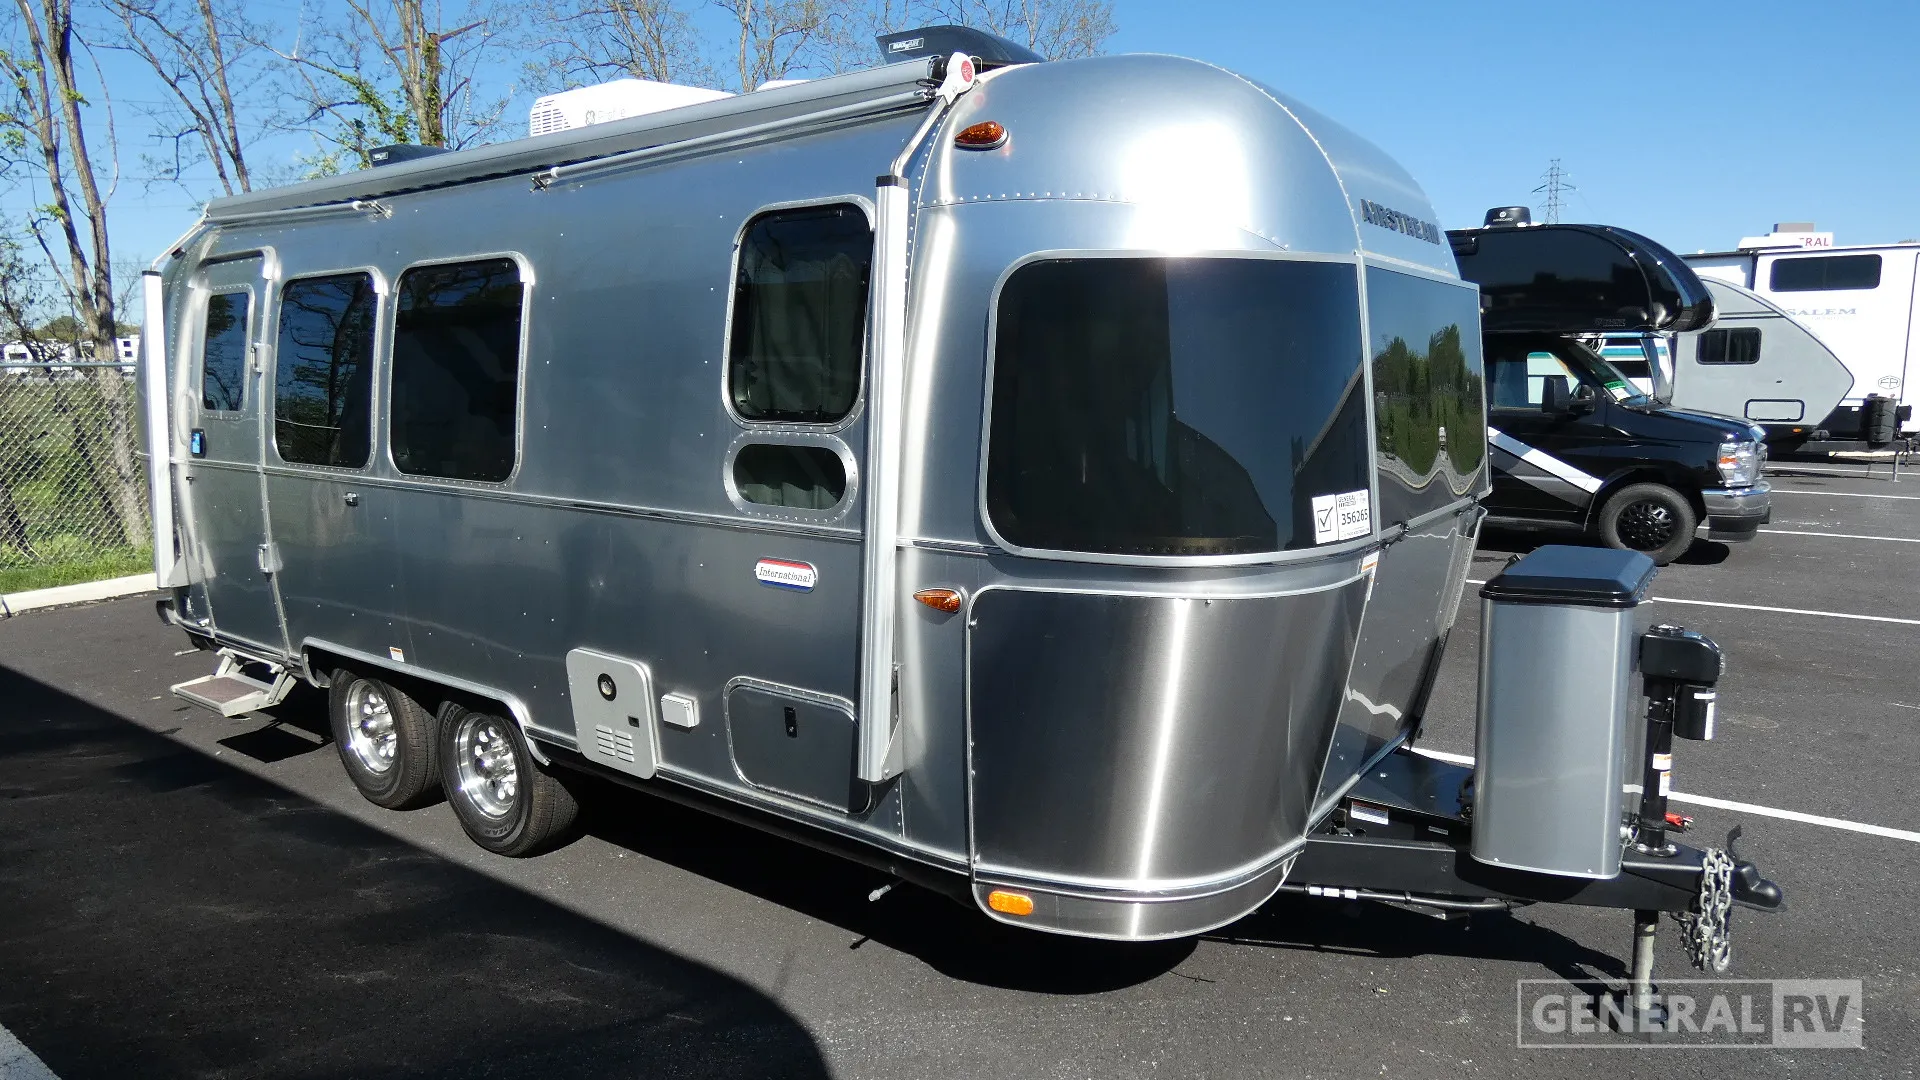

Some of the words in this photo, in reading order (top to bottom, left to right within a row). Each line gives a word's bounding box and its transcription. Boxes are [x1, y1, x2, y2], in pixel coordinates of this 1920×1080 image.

[1360, 198, 1440, 246] AIRSTREAM
[1799, 237, 1829, 247] RAL
[1786, 308, 1857, 316] SALEM
[1341, 508, 1368, 526] 356265
[759, 566, 812, 583] International
